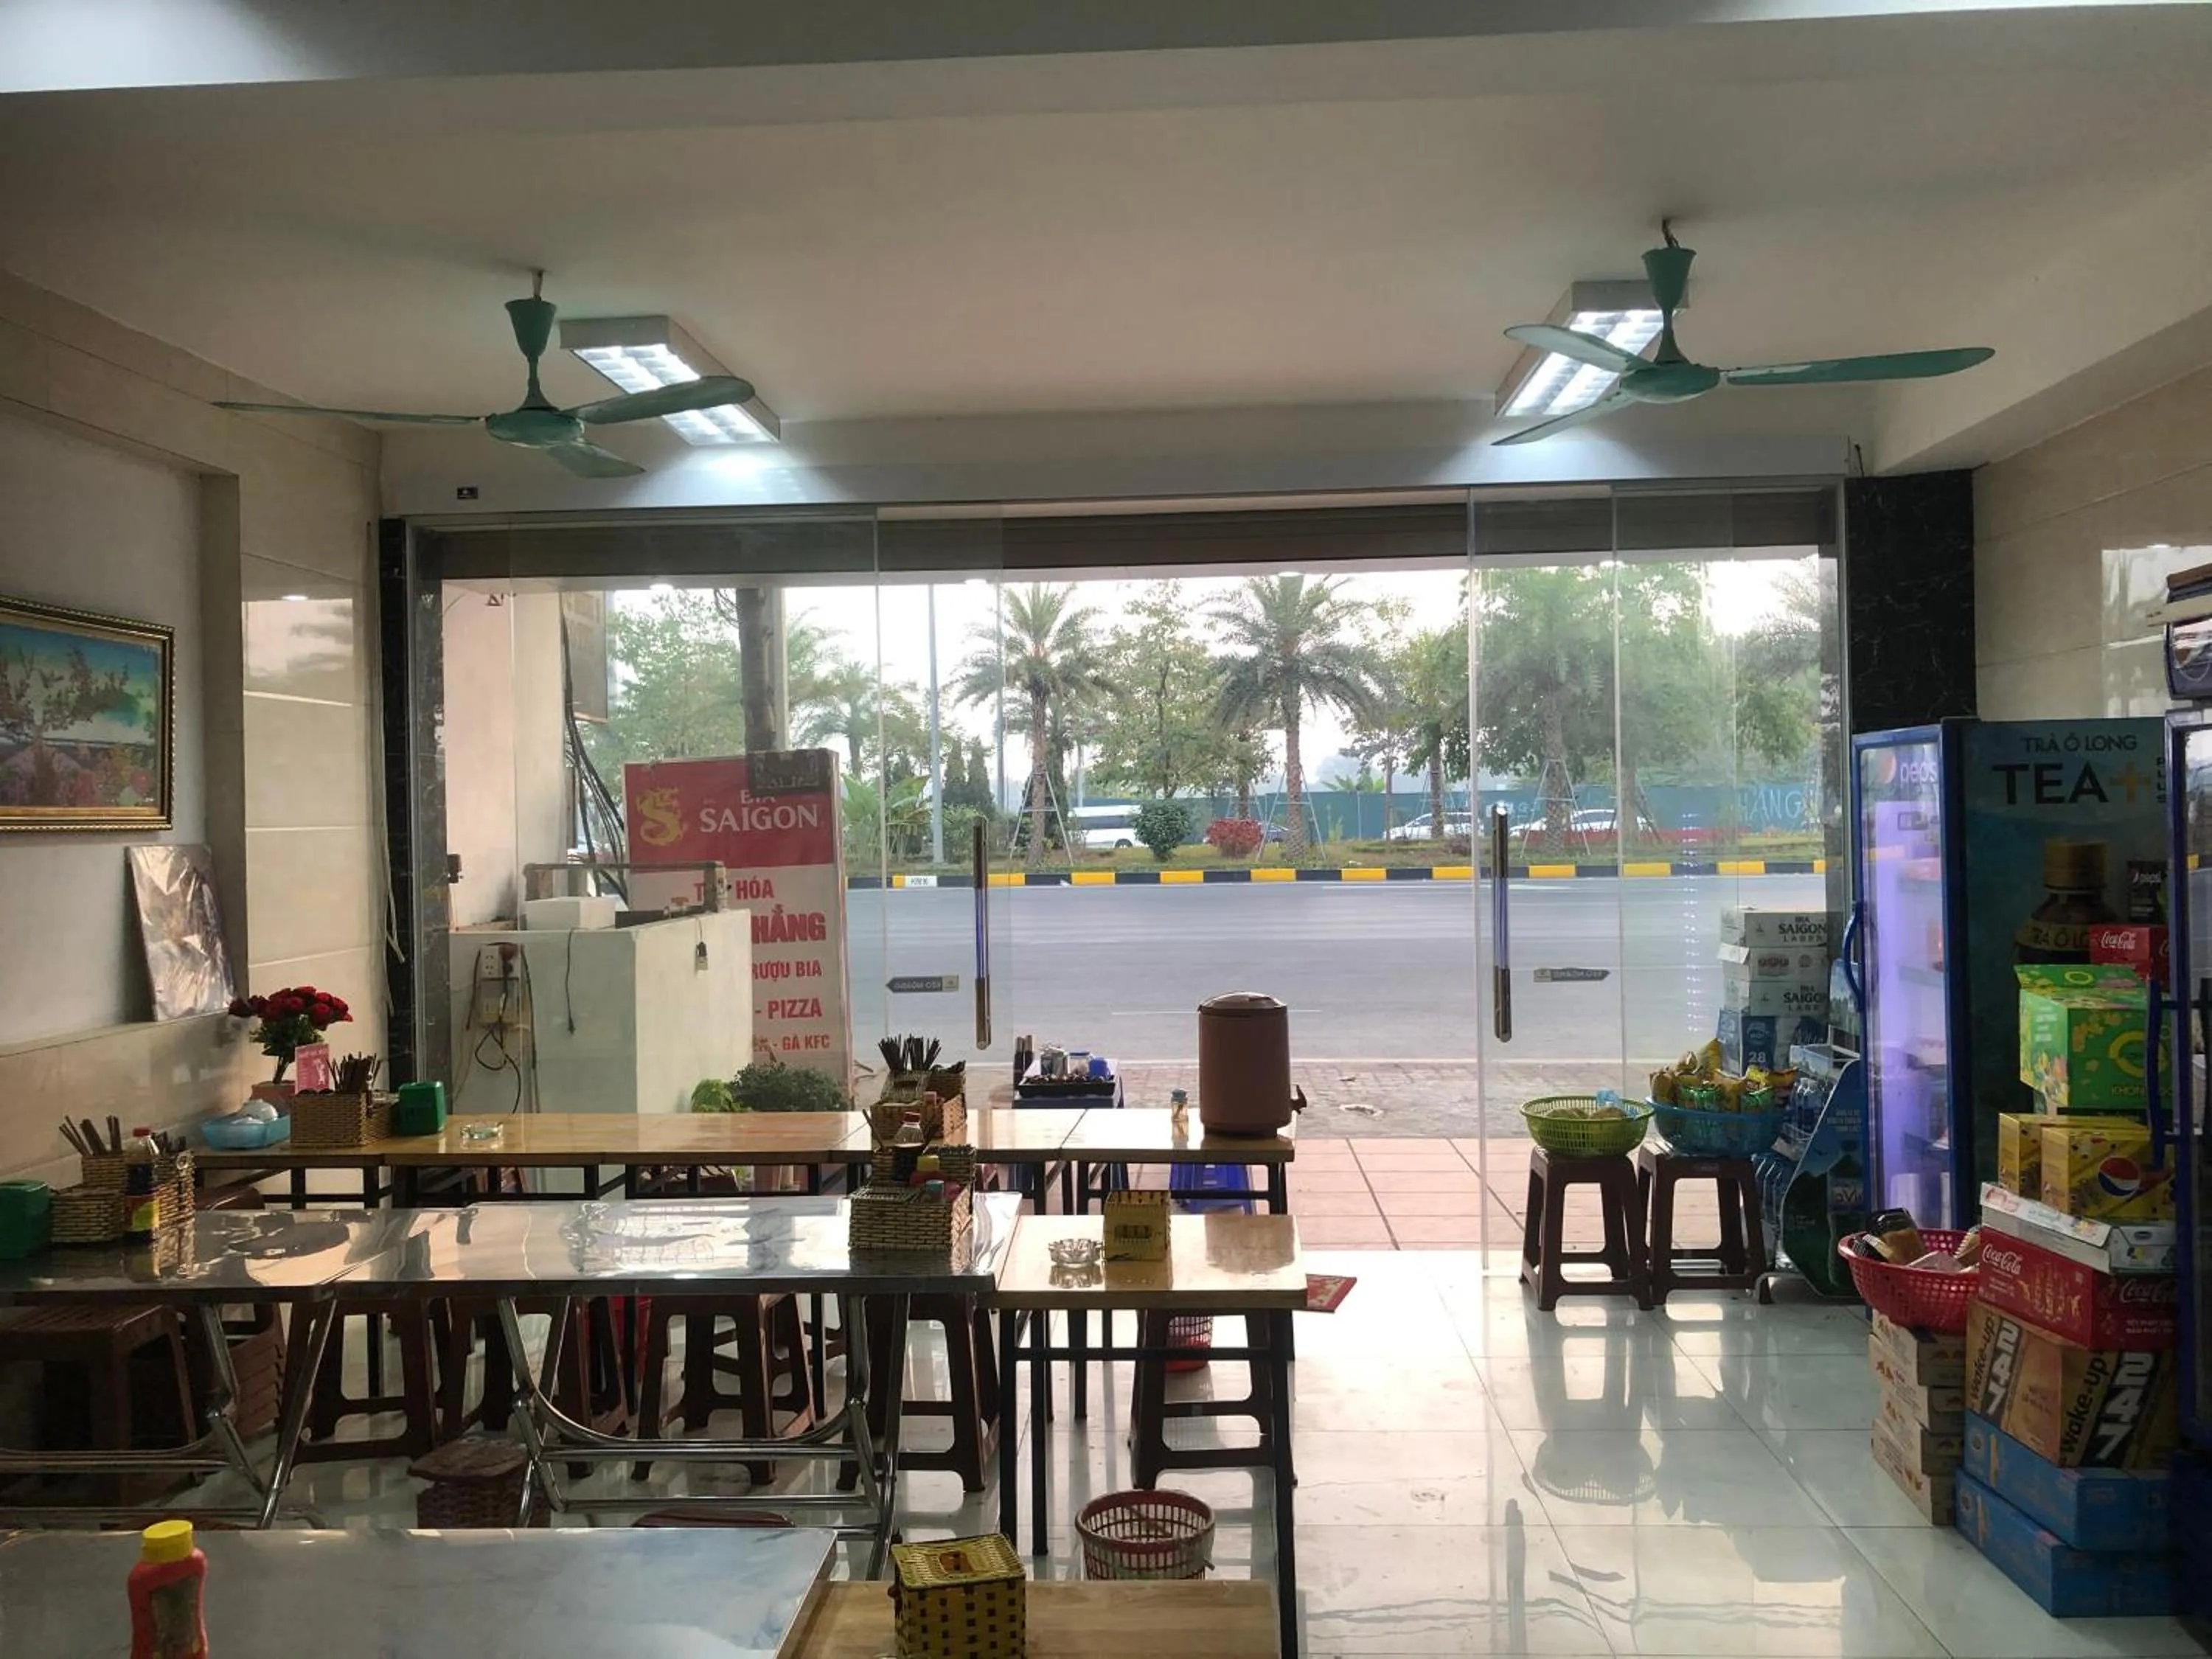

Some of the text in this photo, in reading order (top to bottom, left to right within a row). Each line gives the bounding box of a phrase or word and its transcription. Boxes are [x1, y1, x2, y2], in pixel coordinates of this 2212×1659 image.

[2085, 734, 2138, 751] LONG
[1899, 760, 1938, 787] peps
[699, 803, 819, 834] SAIGON
[735, 875, 775, 900] HÓA
[1778, 923, 1827, 934] SAIGON
[796, 959, 822, 978] BIA
[1783, 992, 1826, 1004] SAIGO
[768, 998, 823, 1020] PIZZA
[804, 1034, 831, 1050] KFC
[1748, 1051, 1767, 1063] 28
[1986, 1316, 2021, 1417] 247
[2095, 1351, 2154, 1460] 247
